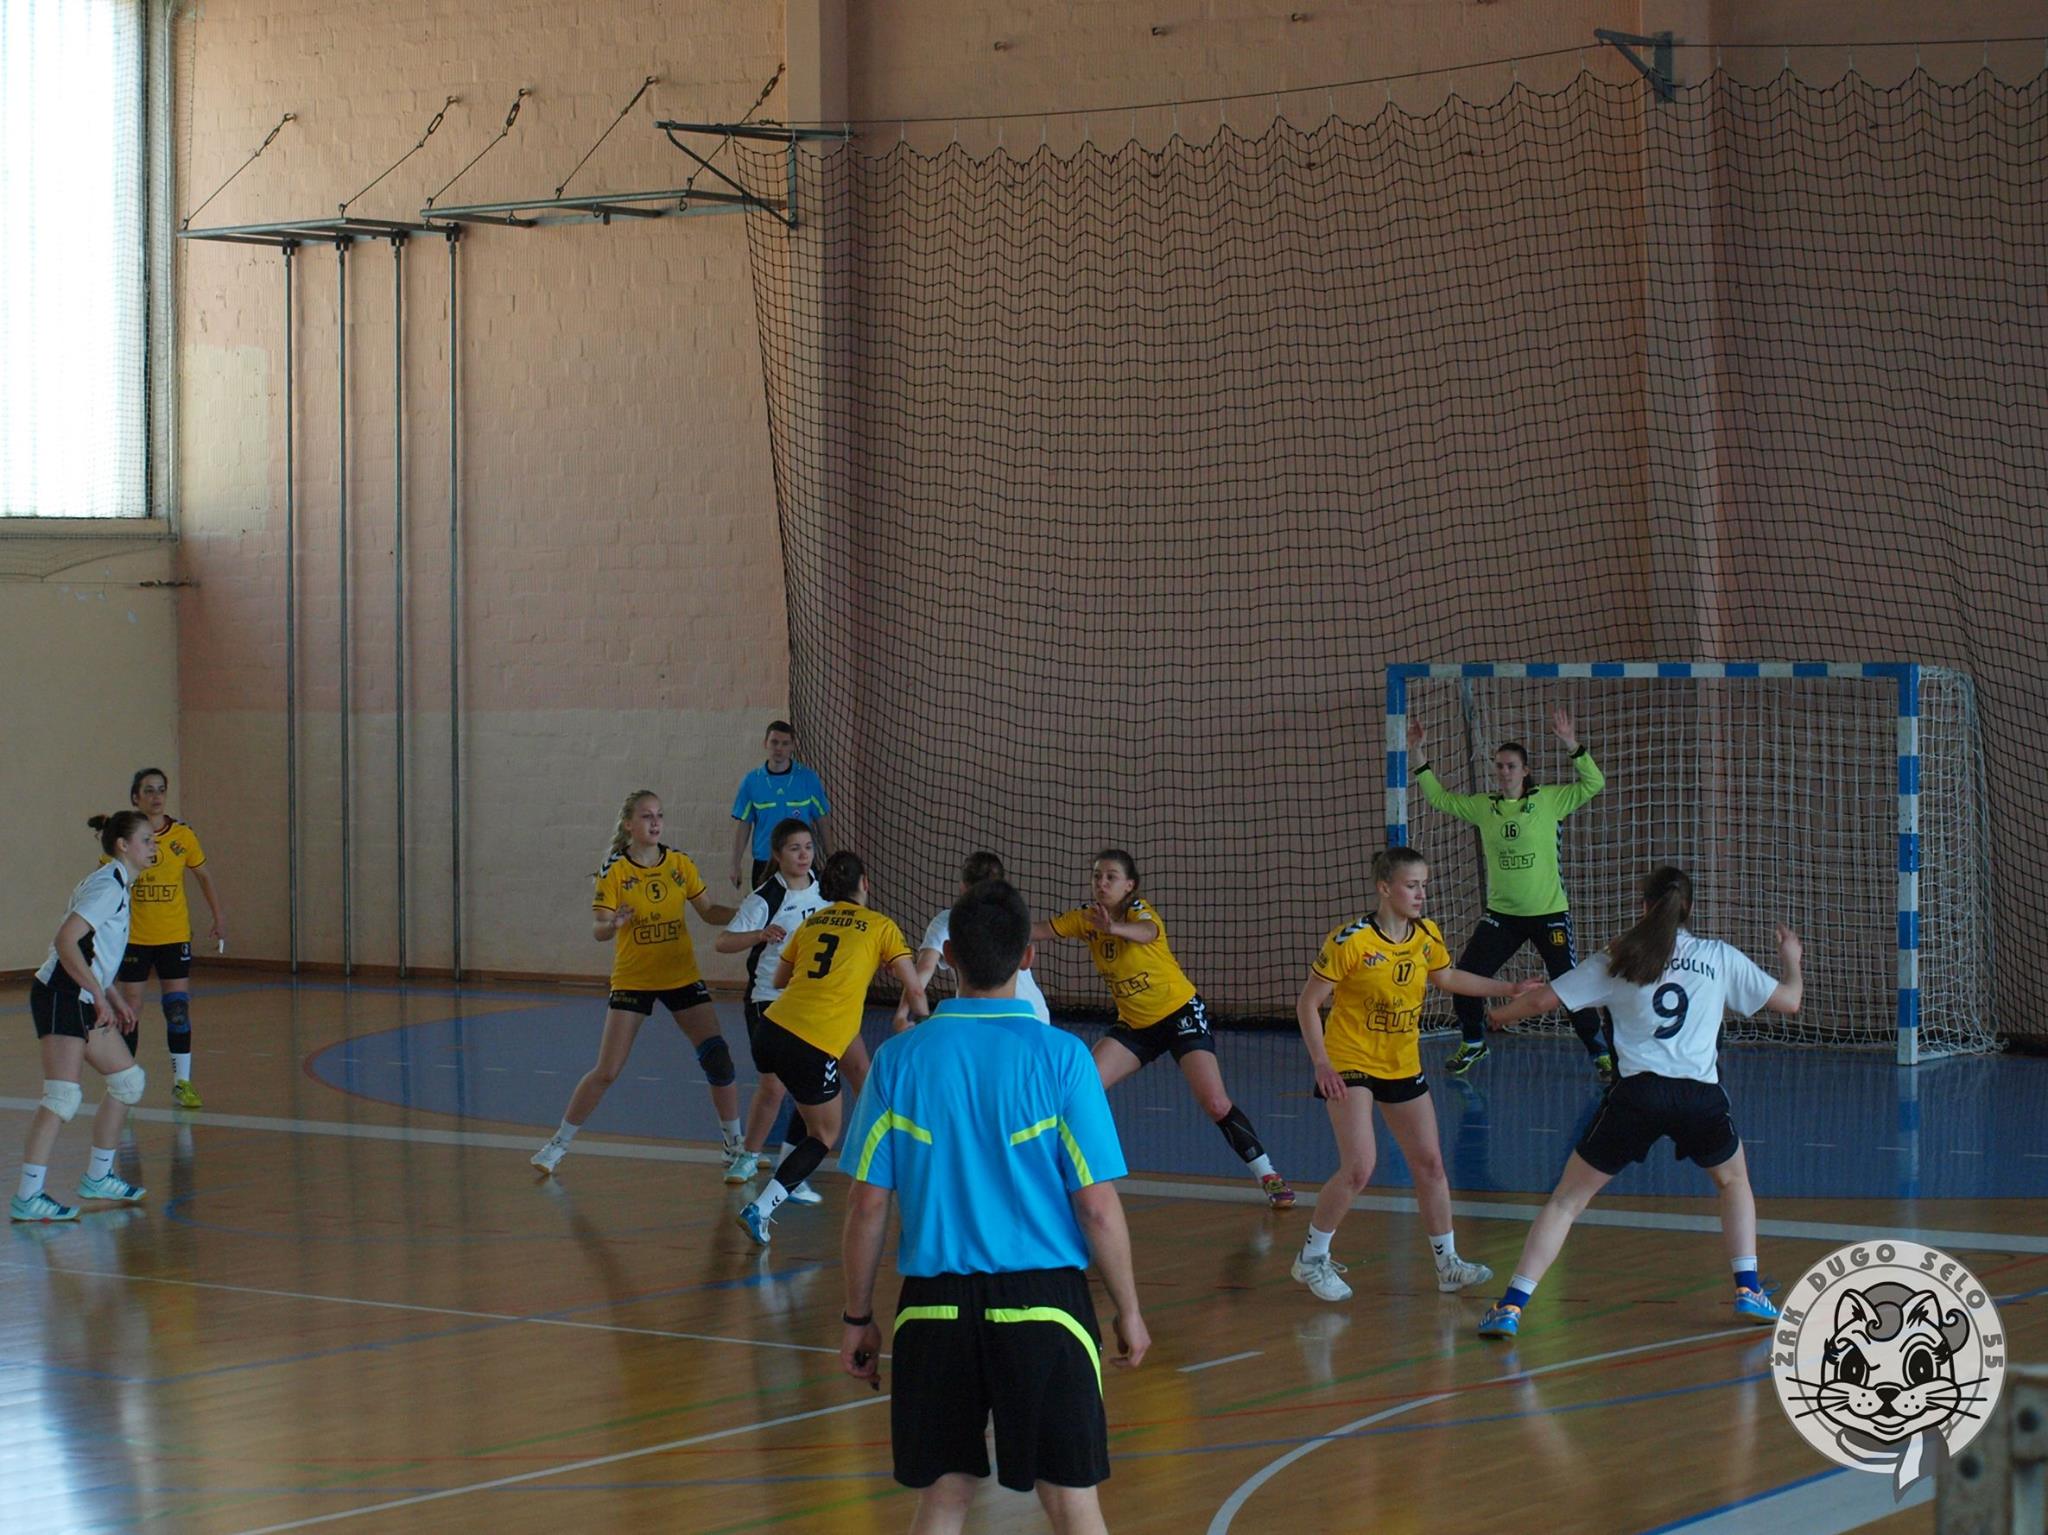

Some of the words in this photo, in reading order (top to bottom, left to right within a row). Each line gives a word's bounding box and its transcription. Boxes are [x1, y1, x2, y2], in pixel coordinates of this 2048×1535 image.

[1504, 824, 1517, 838] 16
[1499, 853, 1536, 870] CULT
[651, 883, 661, 899] 5
[1552, 931, 1565, 944] 16
[807, 932, 840, 979] 3
[1105, 942, 1115, 959] 15
[1397, 962, 1412, 982] 17
[1652, 982, 1689, 1040] 9
